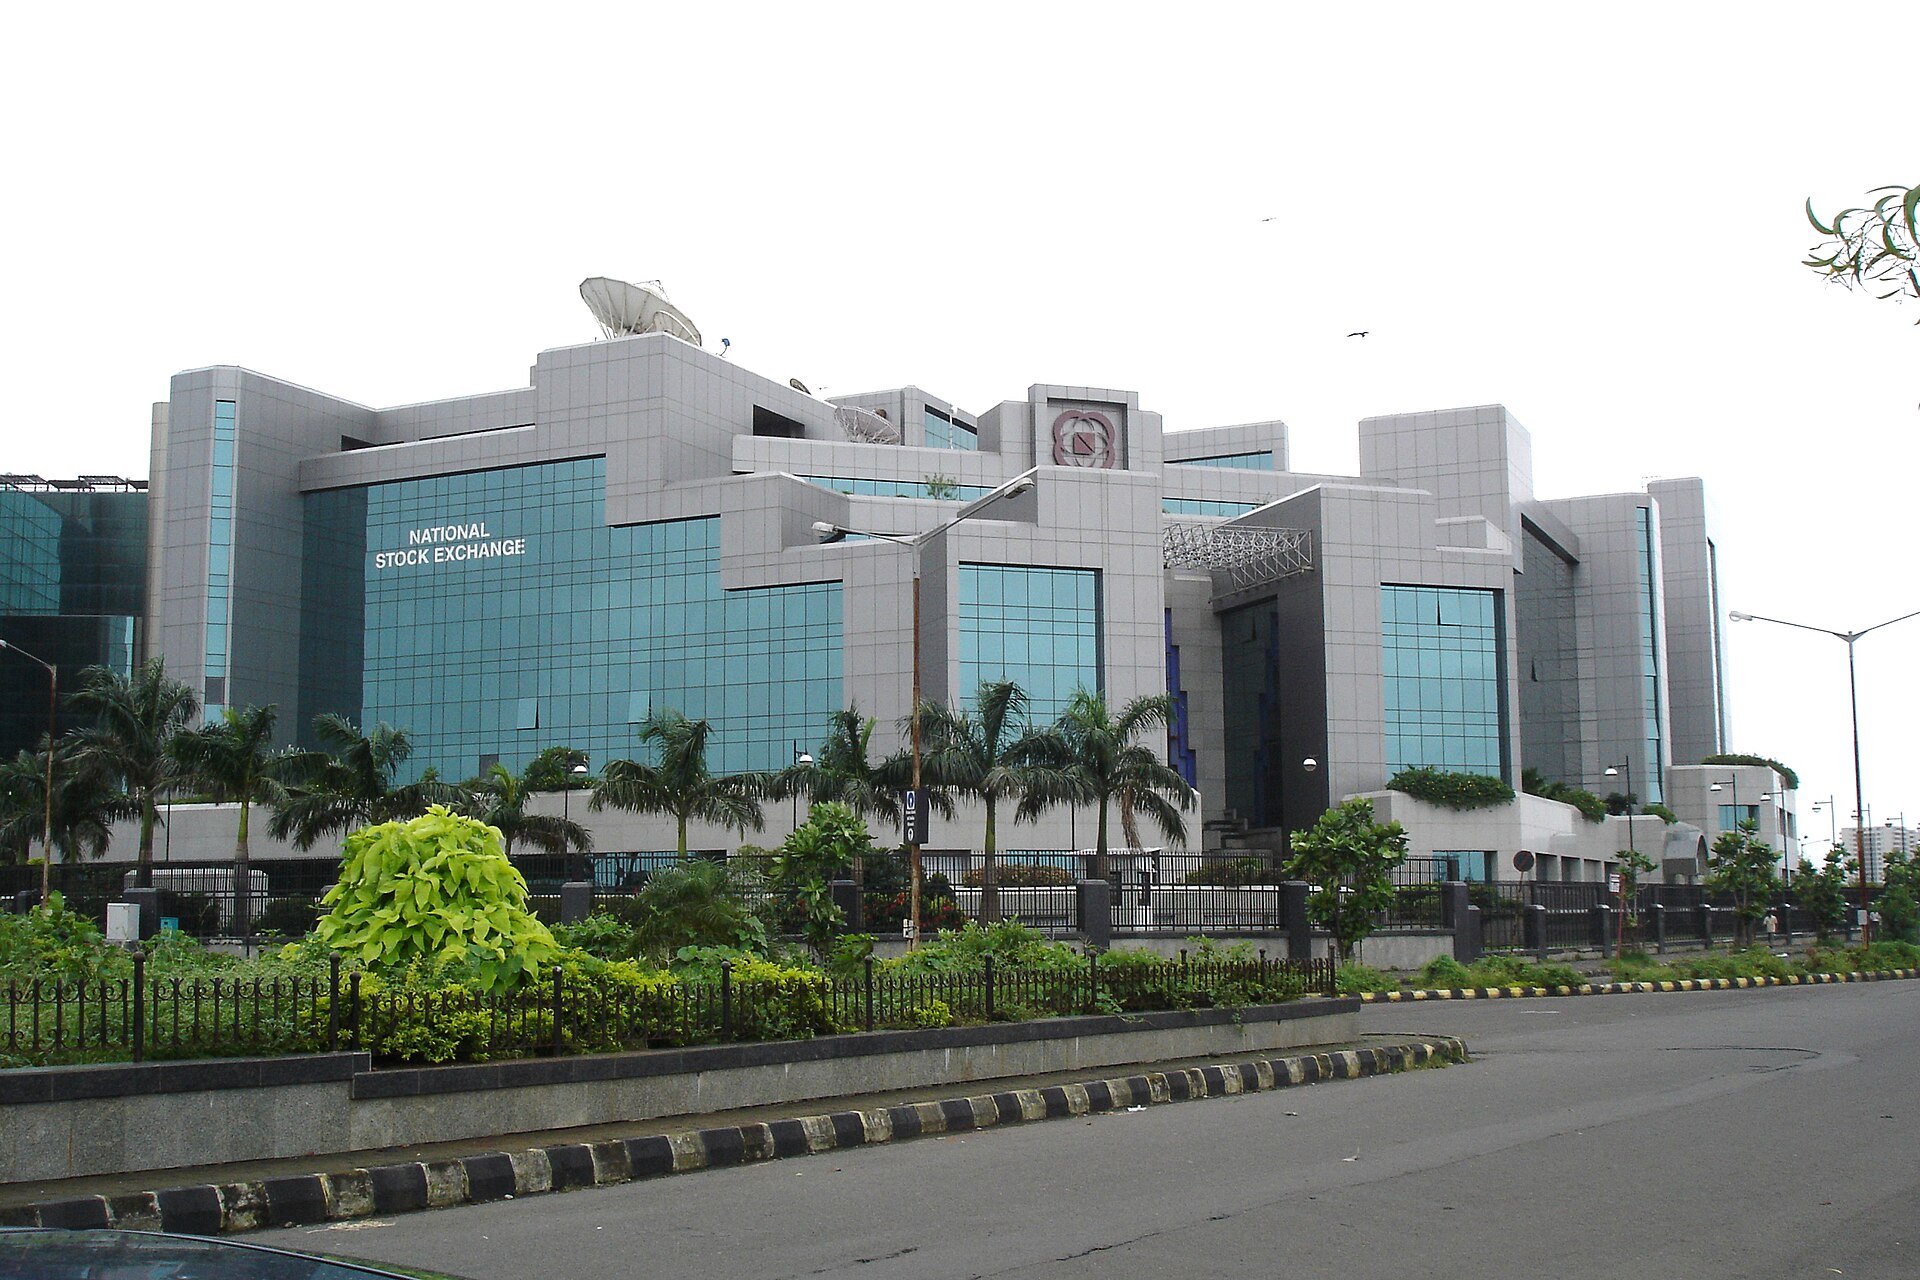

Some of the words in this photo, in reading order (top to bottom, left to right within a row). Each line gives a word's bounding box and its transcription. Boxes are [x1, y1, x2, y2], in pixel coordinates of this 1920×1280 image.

[409, 522, 490, 545] NATIONAL
[375, 548, 429, 569] STOCK
[434, 538, 525, 563] EXCHANGE
